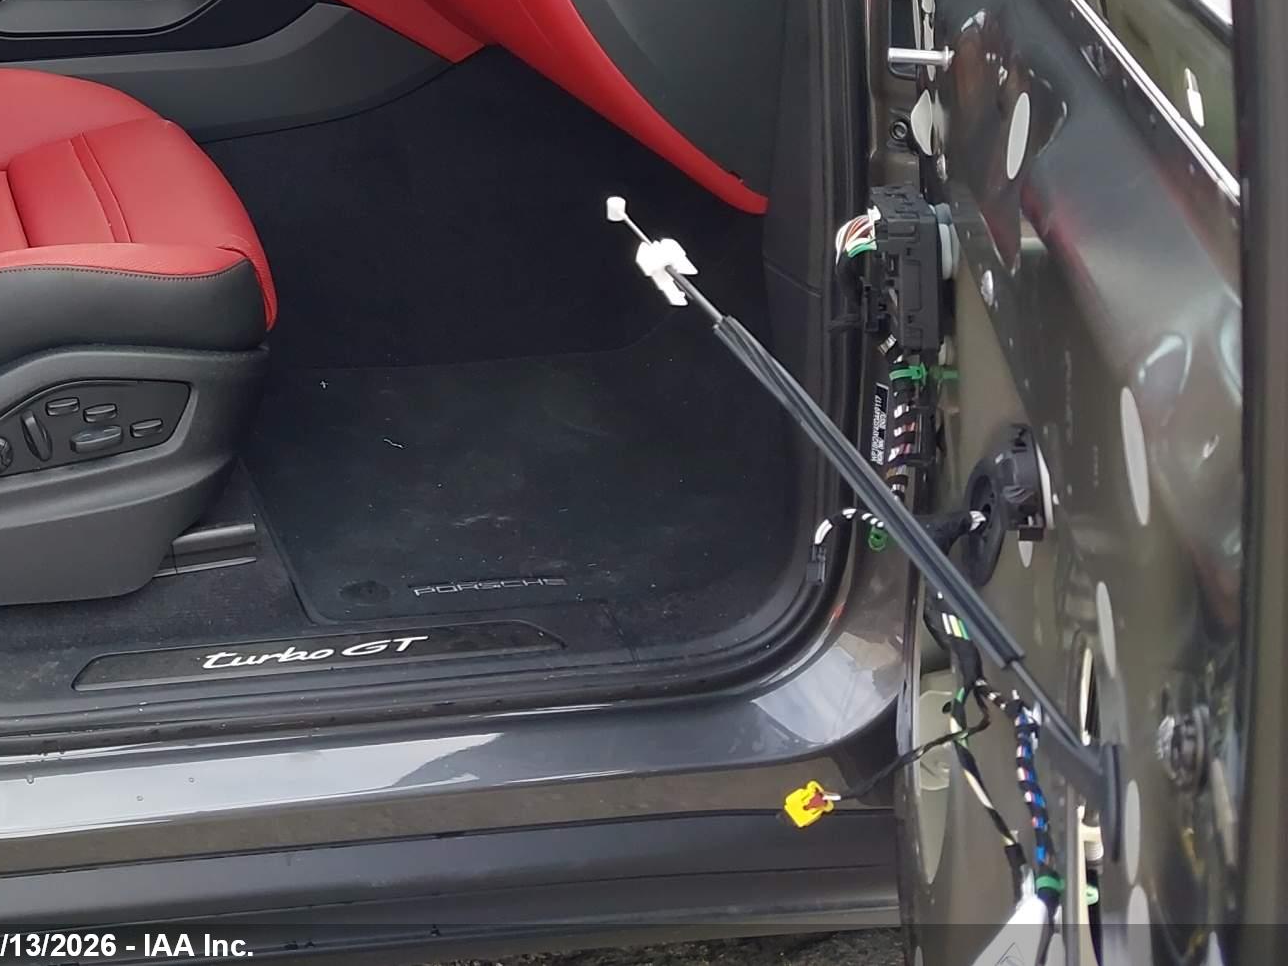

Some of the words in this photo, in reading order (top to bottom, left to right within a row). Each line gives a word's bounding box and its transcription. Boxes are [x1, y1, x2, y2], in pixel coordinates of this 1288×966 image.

[414, 578, 568, 596] PORSCHE
[202, 646, 334, 669] turbo
[341, 635, 429, 656] GT
